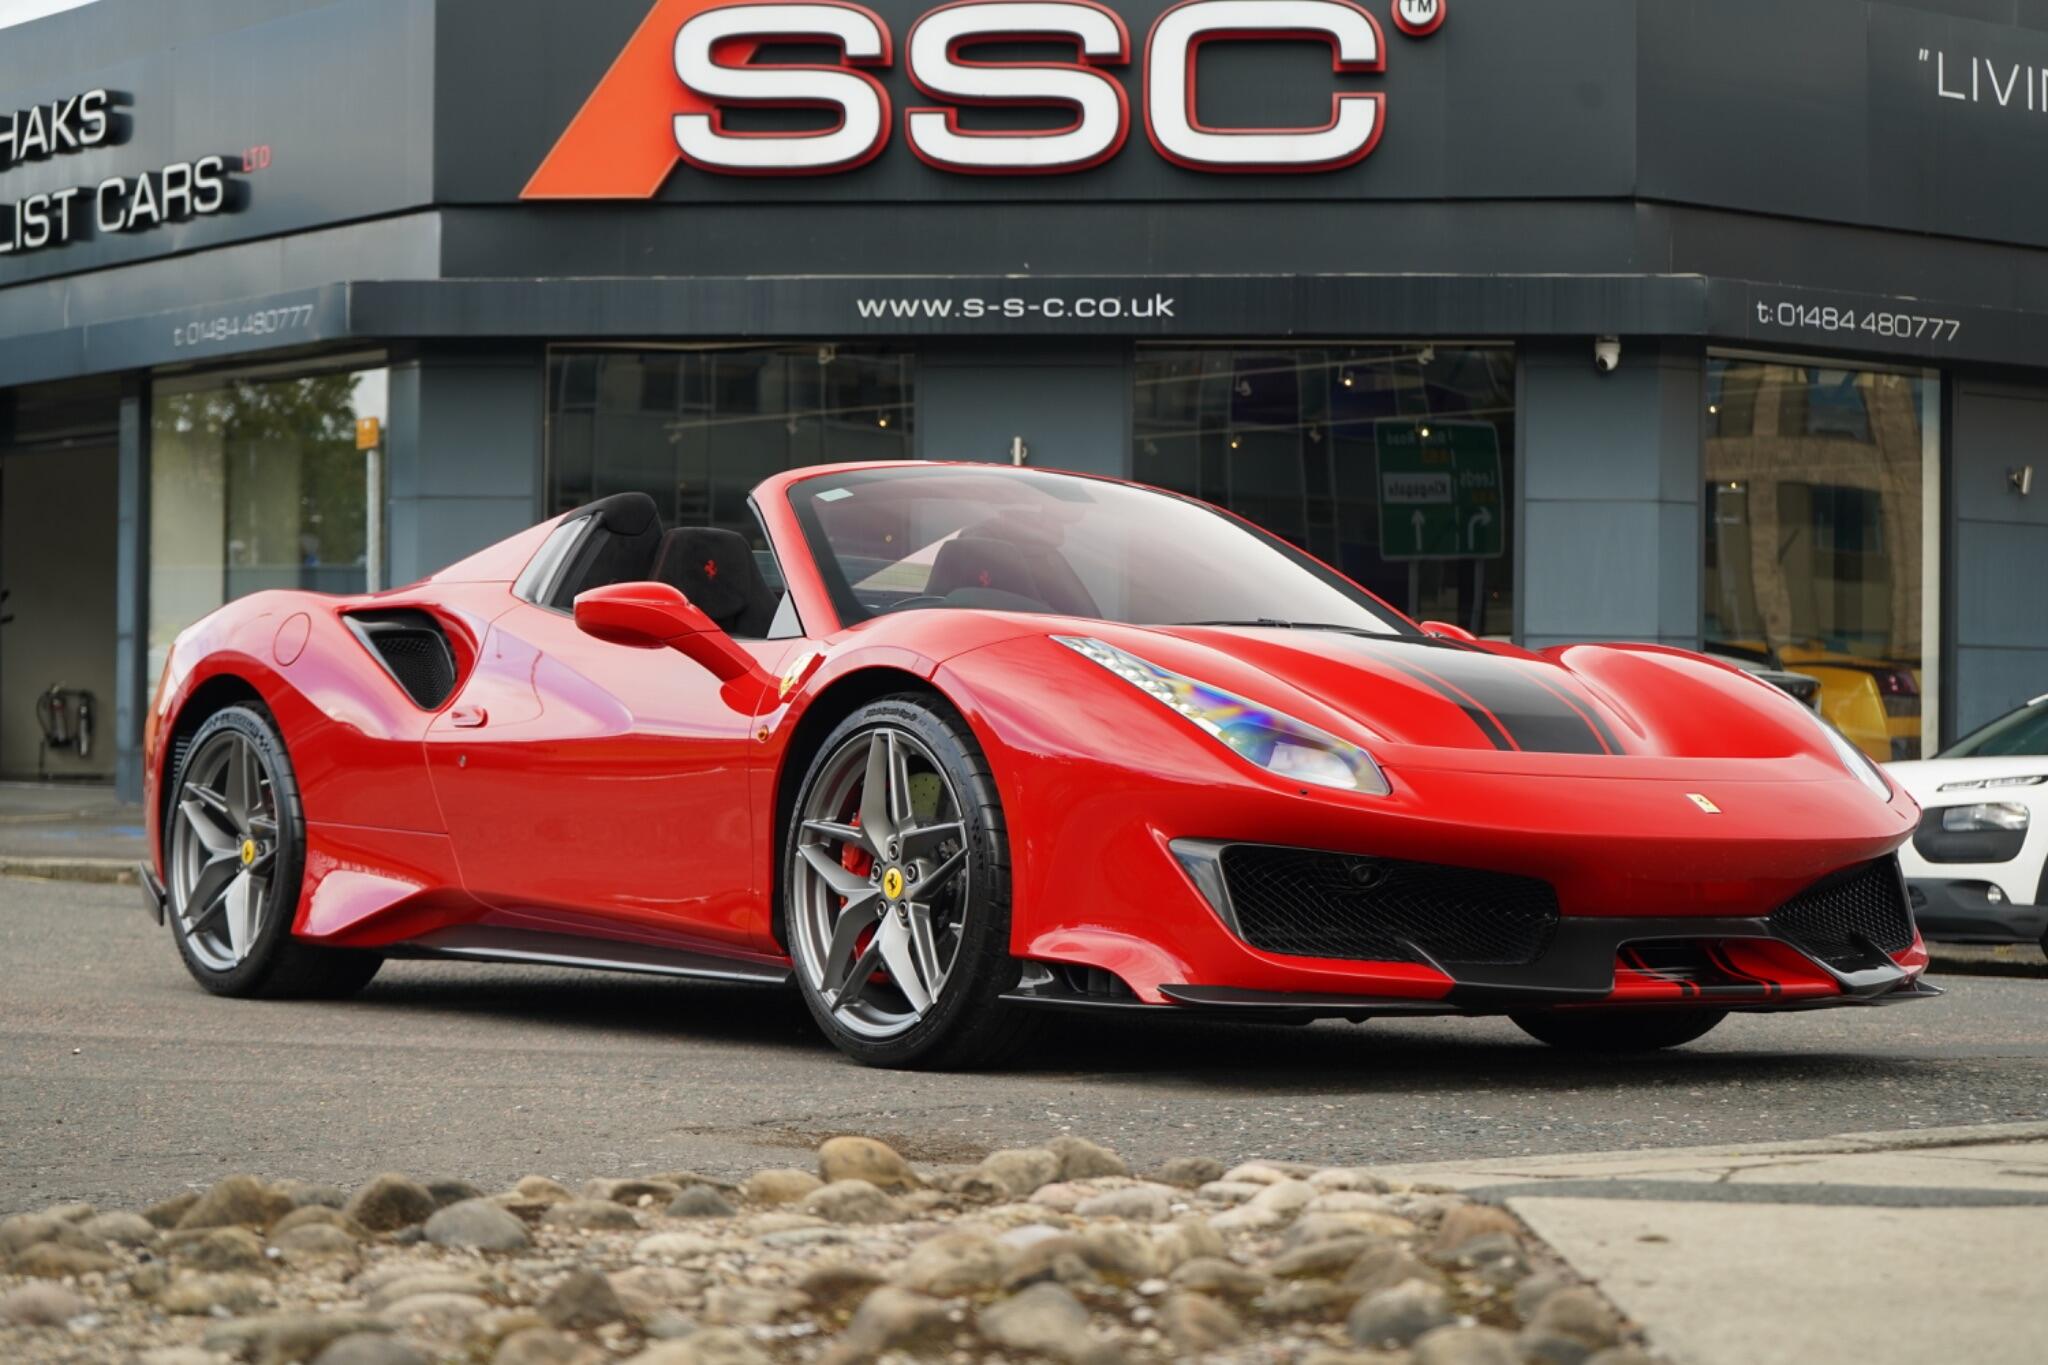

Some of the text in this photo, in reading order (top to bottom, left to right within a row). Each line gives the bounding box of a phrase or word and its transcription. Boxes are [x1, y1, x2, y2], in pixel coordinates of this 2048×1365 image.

[673, 0, 1385, 173] SSC
[1919, 48, 2048, 112] "LIVI
[242, 145, 271, 172] LTD
[97, 155, 223, 232] CARS
[856, 294, 1175, 318] www.s-s-c.co.uk
